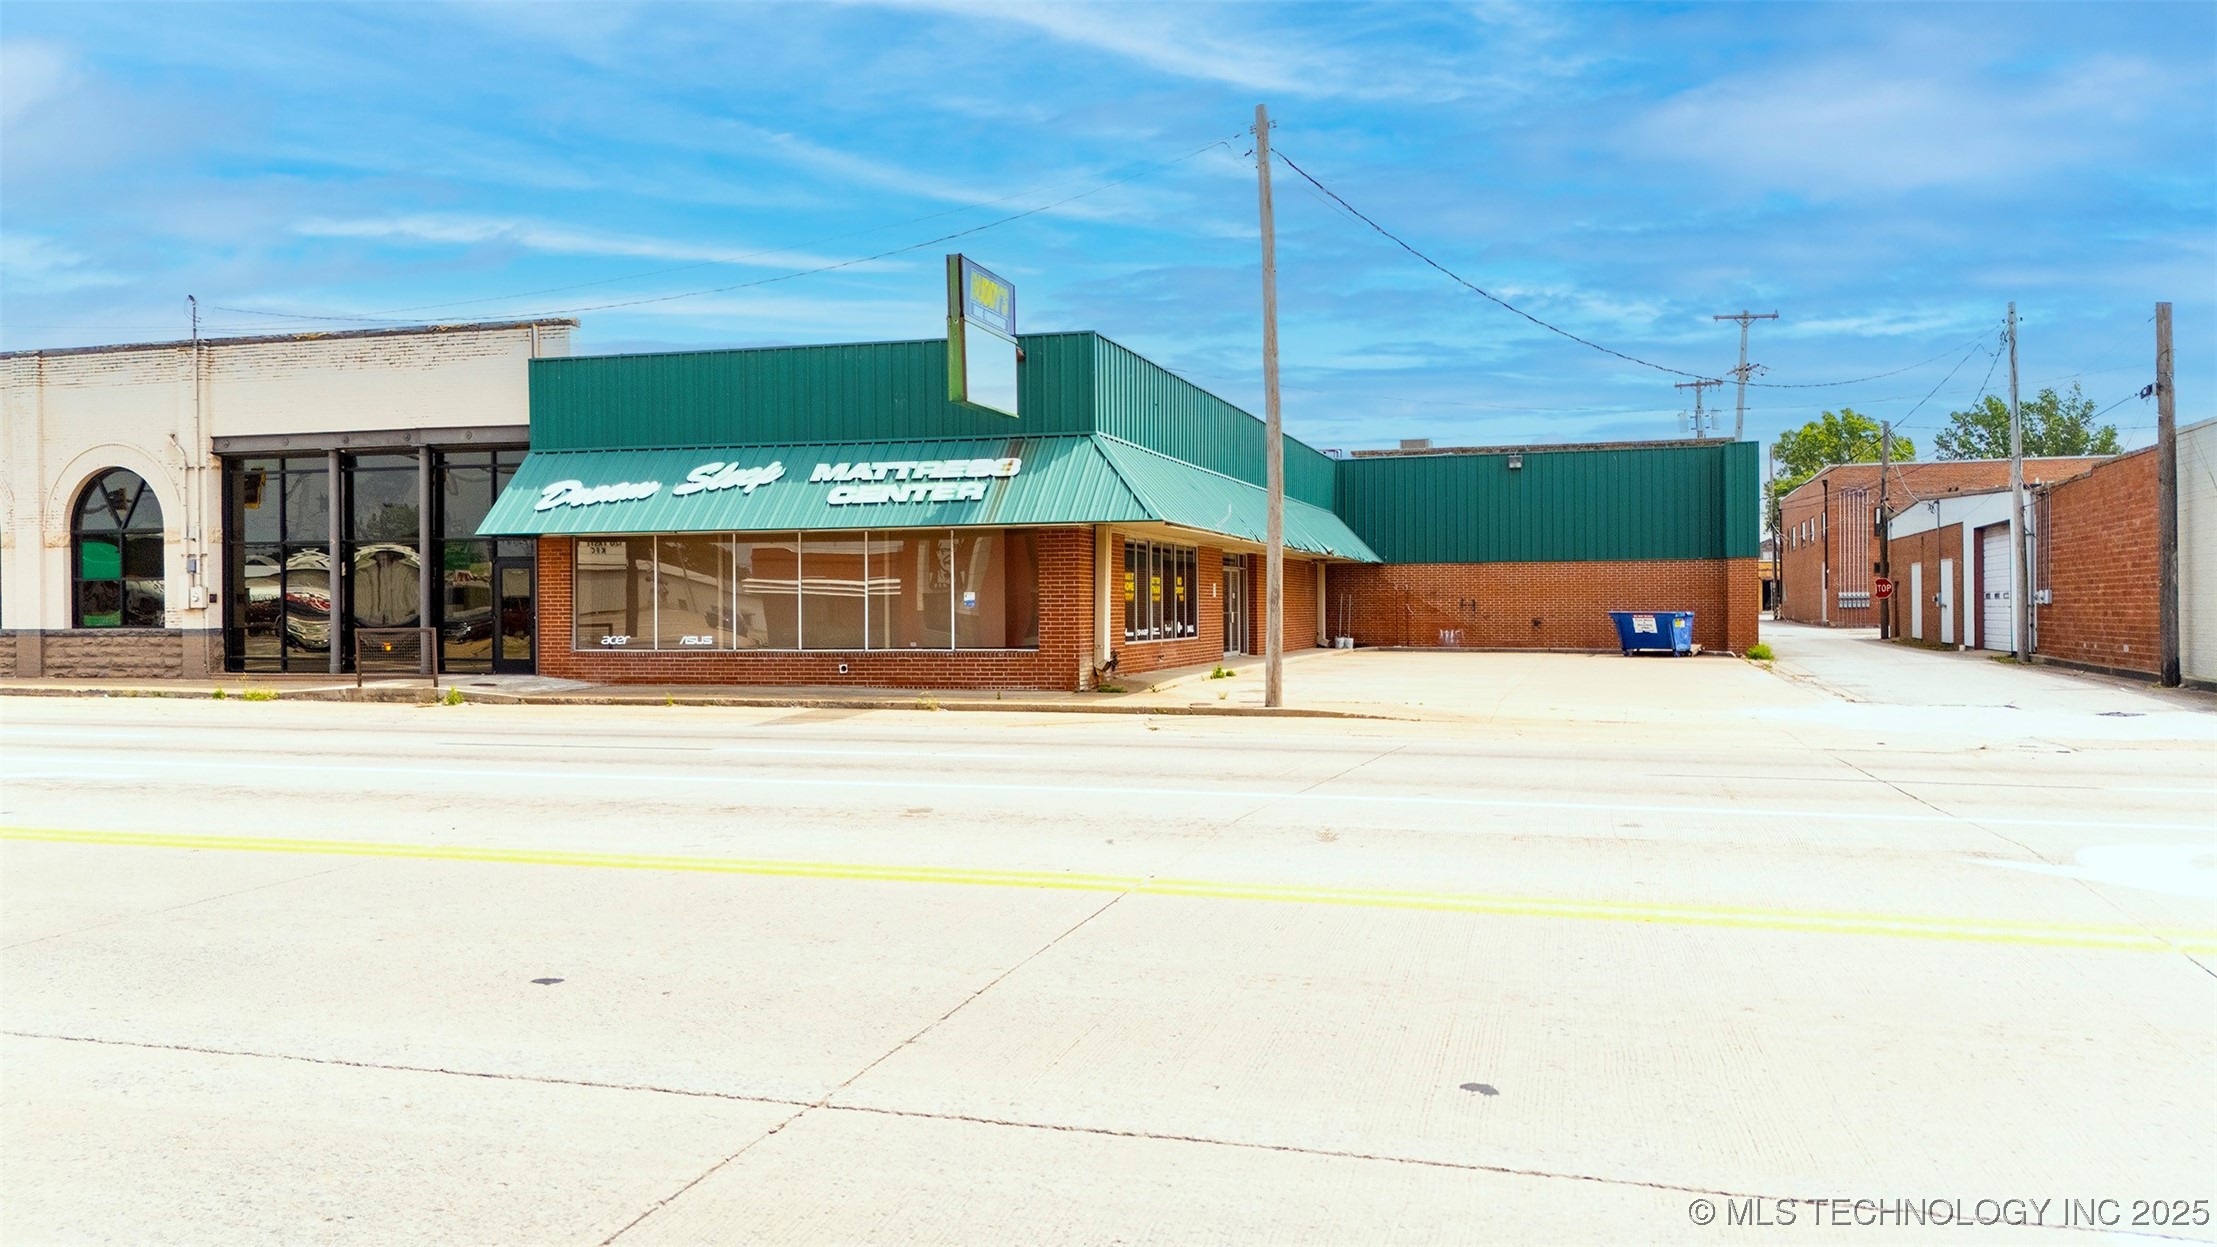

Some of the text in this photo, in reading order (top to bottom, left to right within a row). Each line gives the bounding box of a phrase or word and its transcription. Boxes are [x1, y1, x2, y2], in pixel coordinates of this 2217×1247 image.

[809, 458, 1023, 482] MATTRESS
[826, 481, 989, 506] CENTER
[1877, 584, 1892, 592] TOP
[600, 635, 631, 645] acer
[679, 635, 713, 645] ASUS
